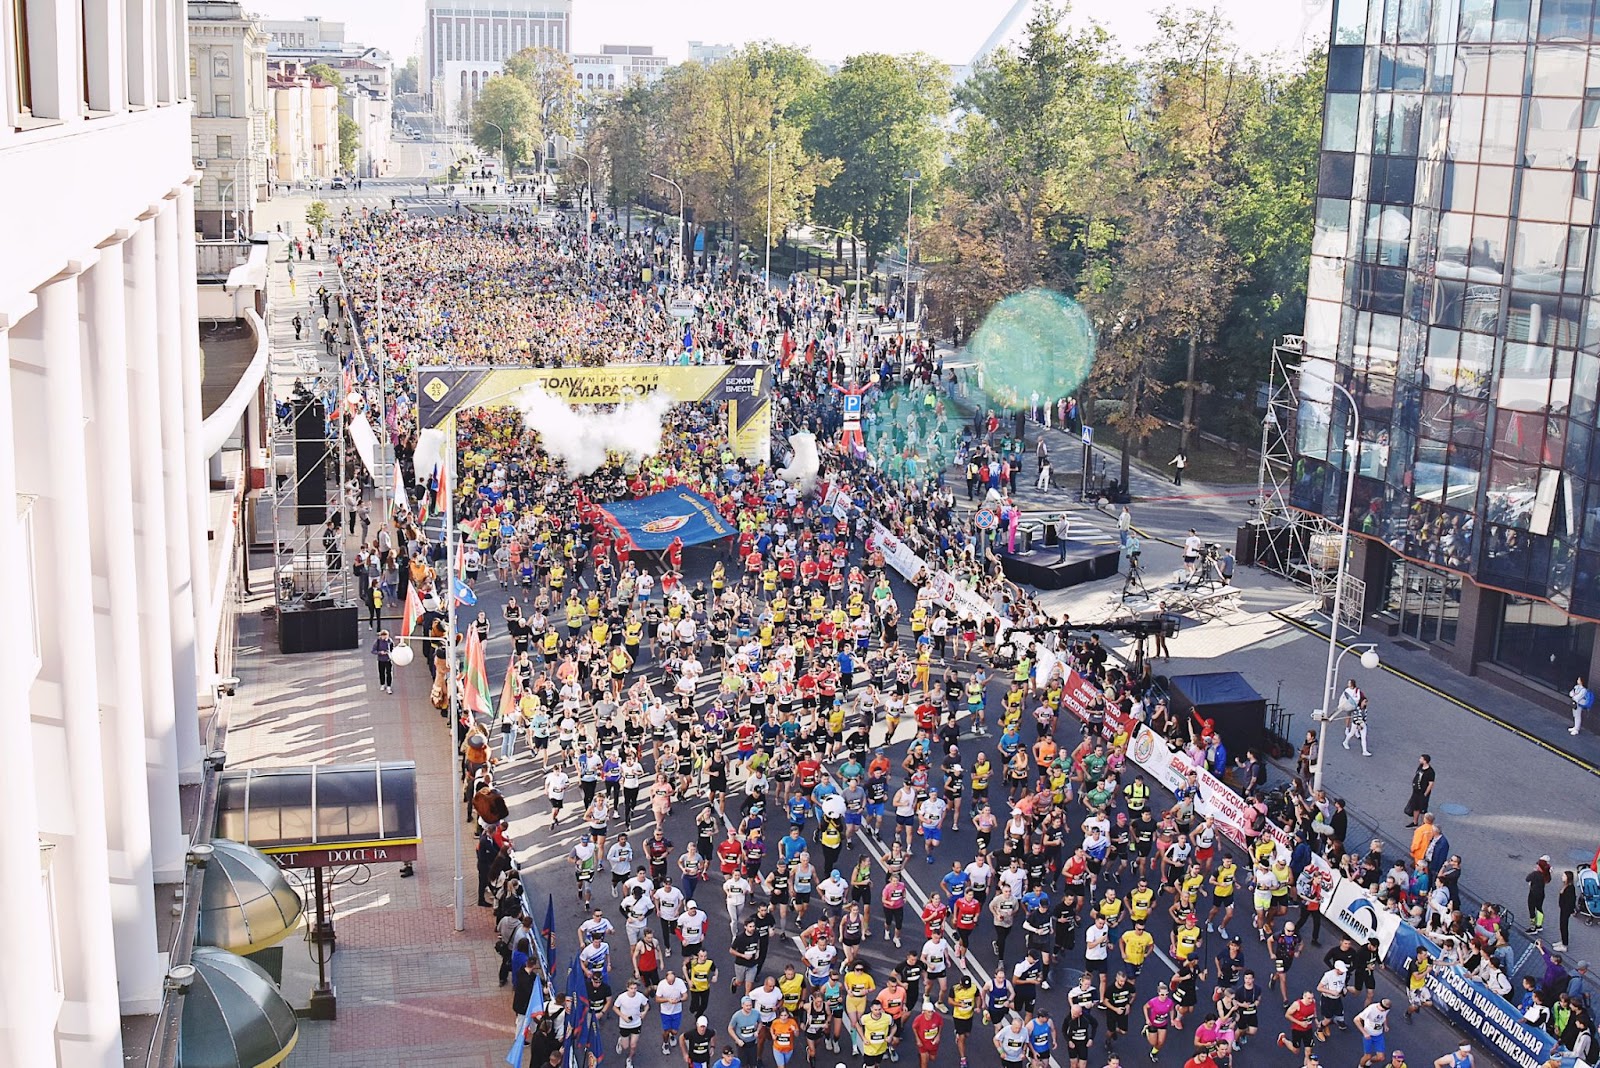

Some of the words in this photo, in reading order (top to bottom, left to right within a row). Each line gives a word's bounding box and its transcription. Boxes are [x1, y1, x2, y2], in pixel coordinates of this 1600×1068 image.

[587, 374, 659, 383] МИНСКИЙ
[1339, 909, 1369, 938] BELARUS
[1473, 994, 1544, 1055] НАЦИОНАЛЬНАЯ
[1481, 1021, 1543, 1068] ОРГАНИЗАЦИ
